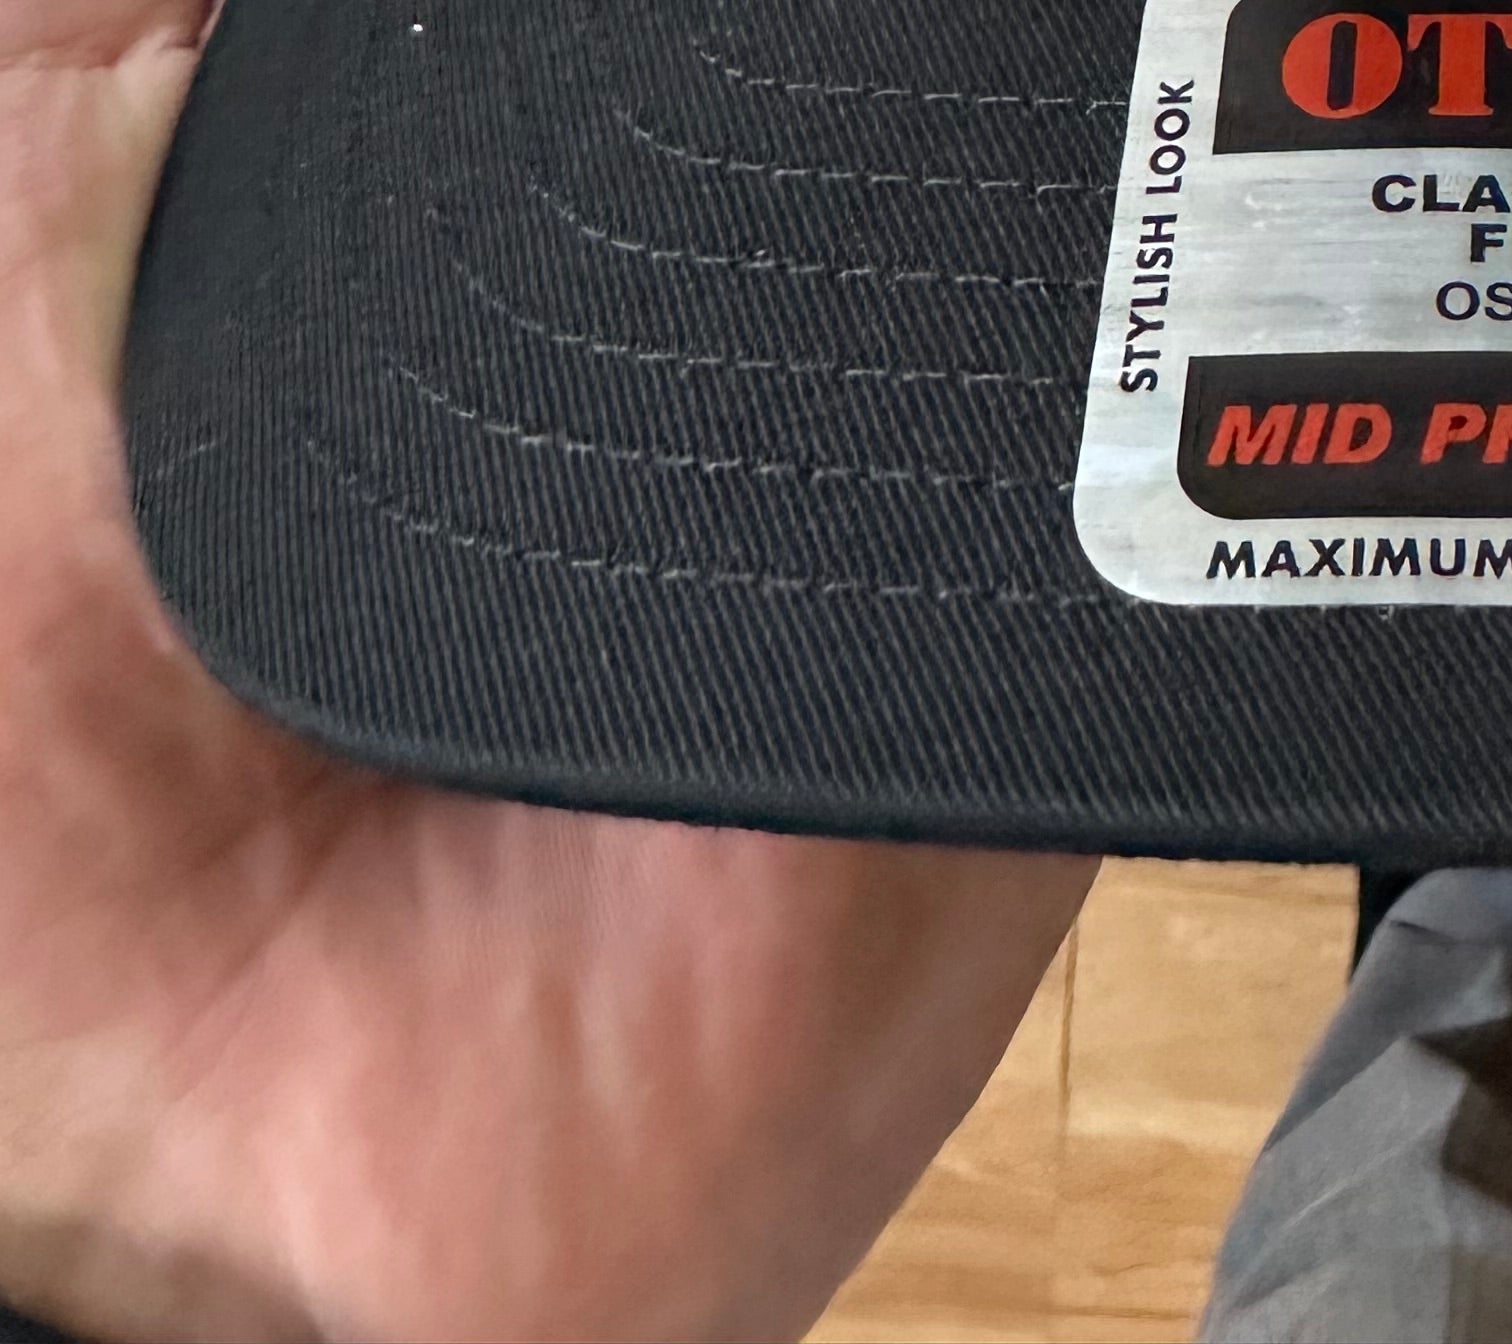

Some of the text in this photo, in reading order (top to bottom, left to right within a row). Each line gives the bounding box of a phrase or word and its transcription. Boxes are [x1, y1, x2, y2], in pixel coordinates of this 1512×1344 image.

[1120, 80, 1195, 392] STYLISH LOOK
[1206, 404, 1392, 466] MID
